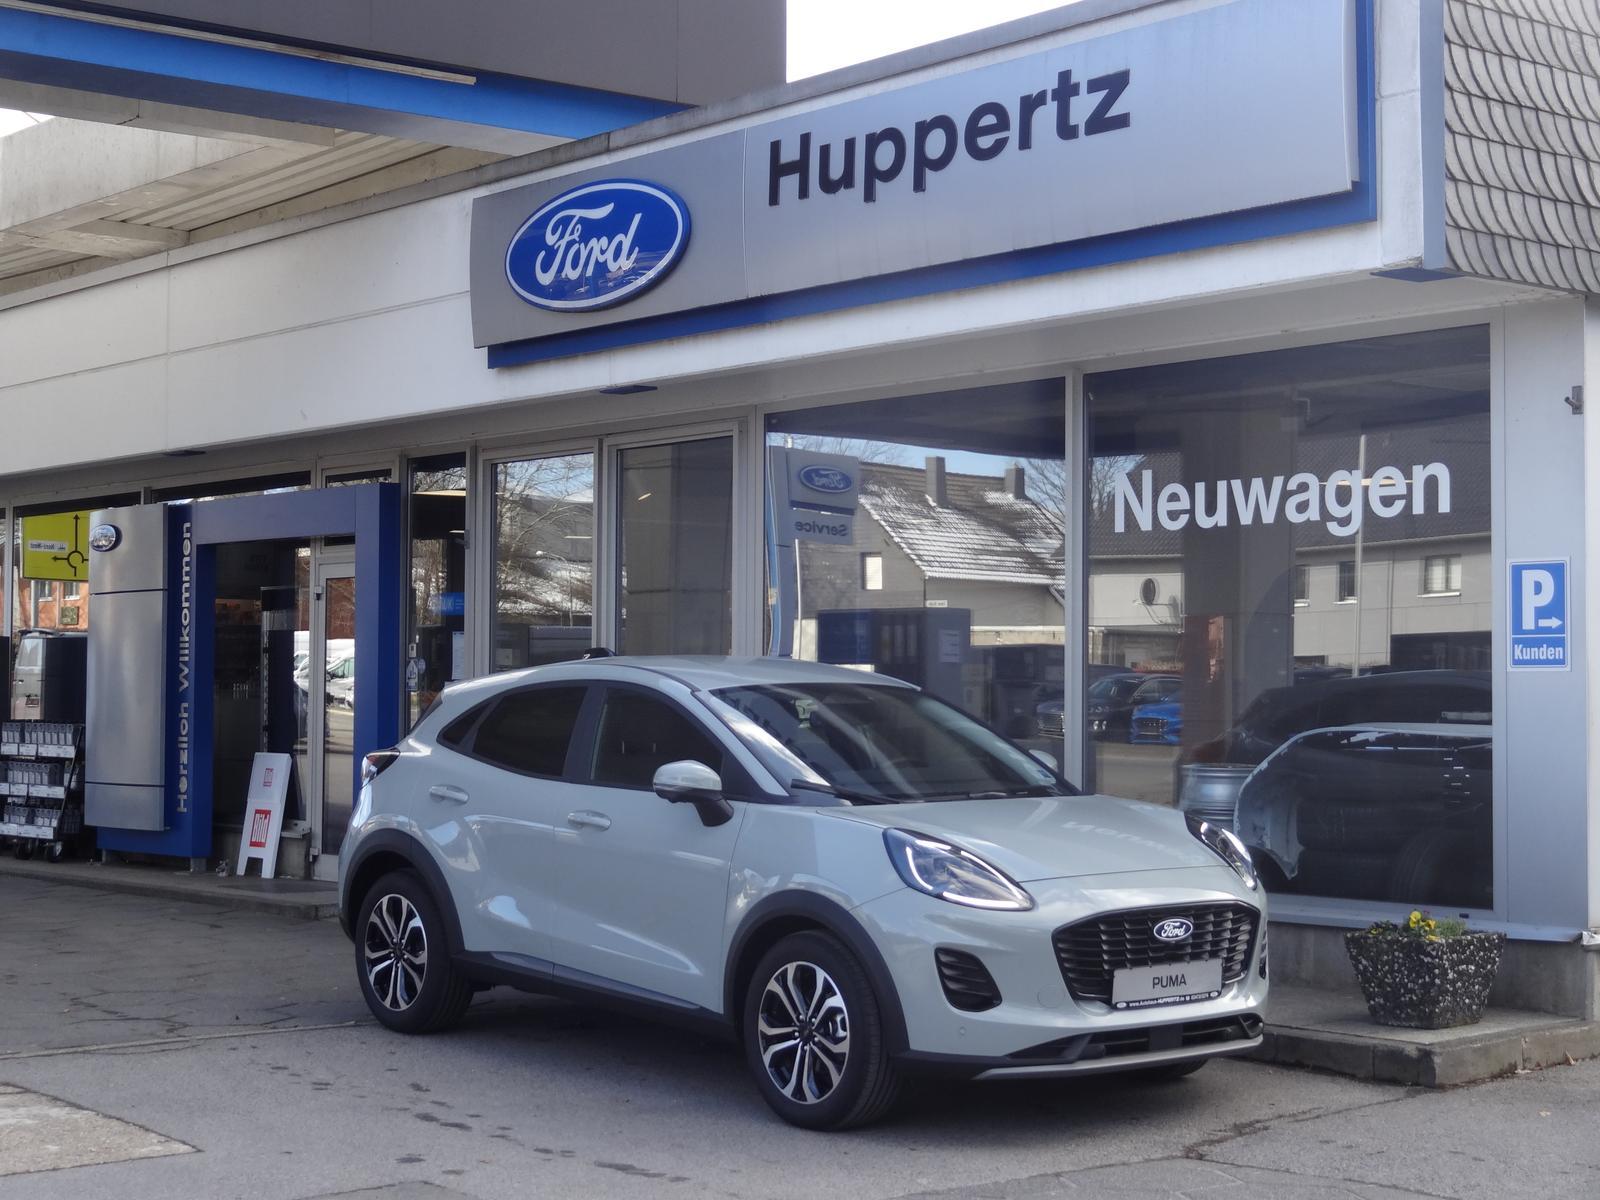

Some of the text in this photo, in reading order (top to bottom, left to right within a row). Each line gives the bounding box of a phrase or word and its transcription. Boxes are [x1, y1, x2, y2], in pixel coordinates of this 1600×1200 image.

[768, 69, 1131, 206] Huppertz
[534, 202, 642, 287] Ford
[1114, 462, 1451, 537] Neuwagen
[1521, 570, 1555, 630] P
[178, 523, 192, 812] Herzlich Willkommen
[1514, 644, 1563, 660] Kunden
[1161, 922, 1186, 937] Ford
[1152, 974, 1187, 989] PUMA
